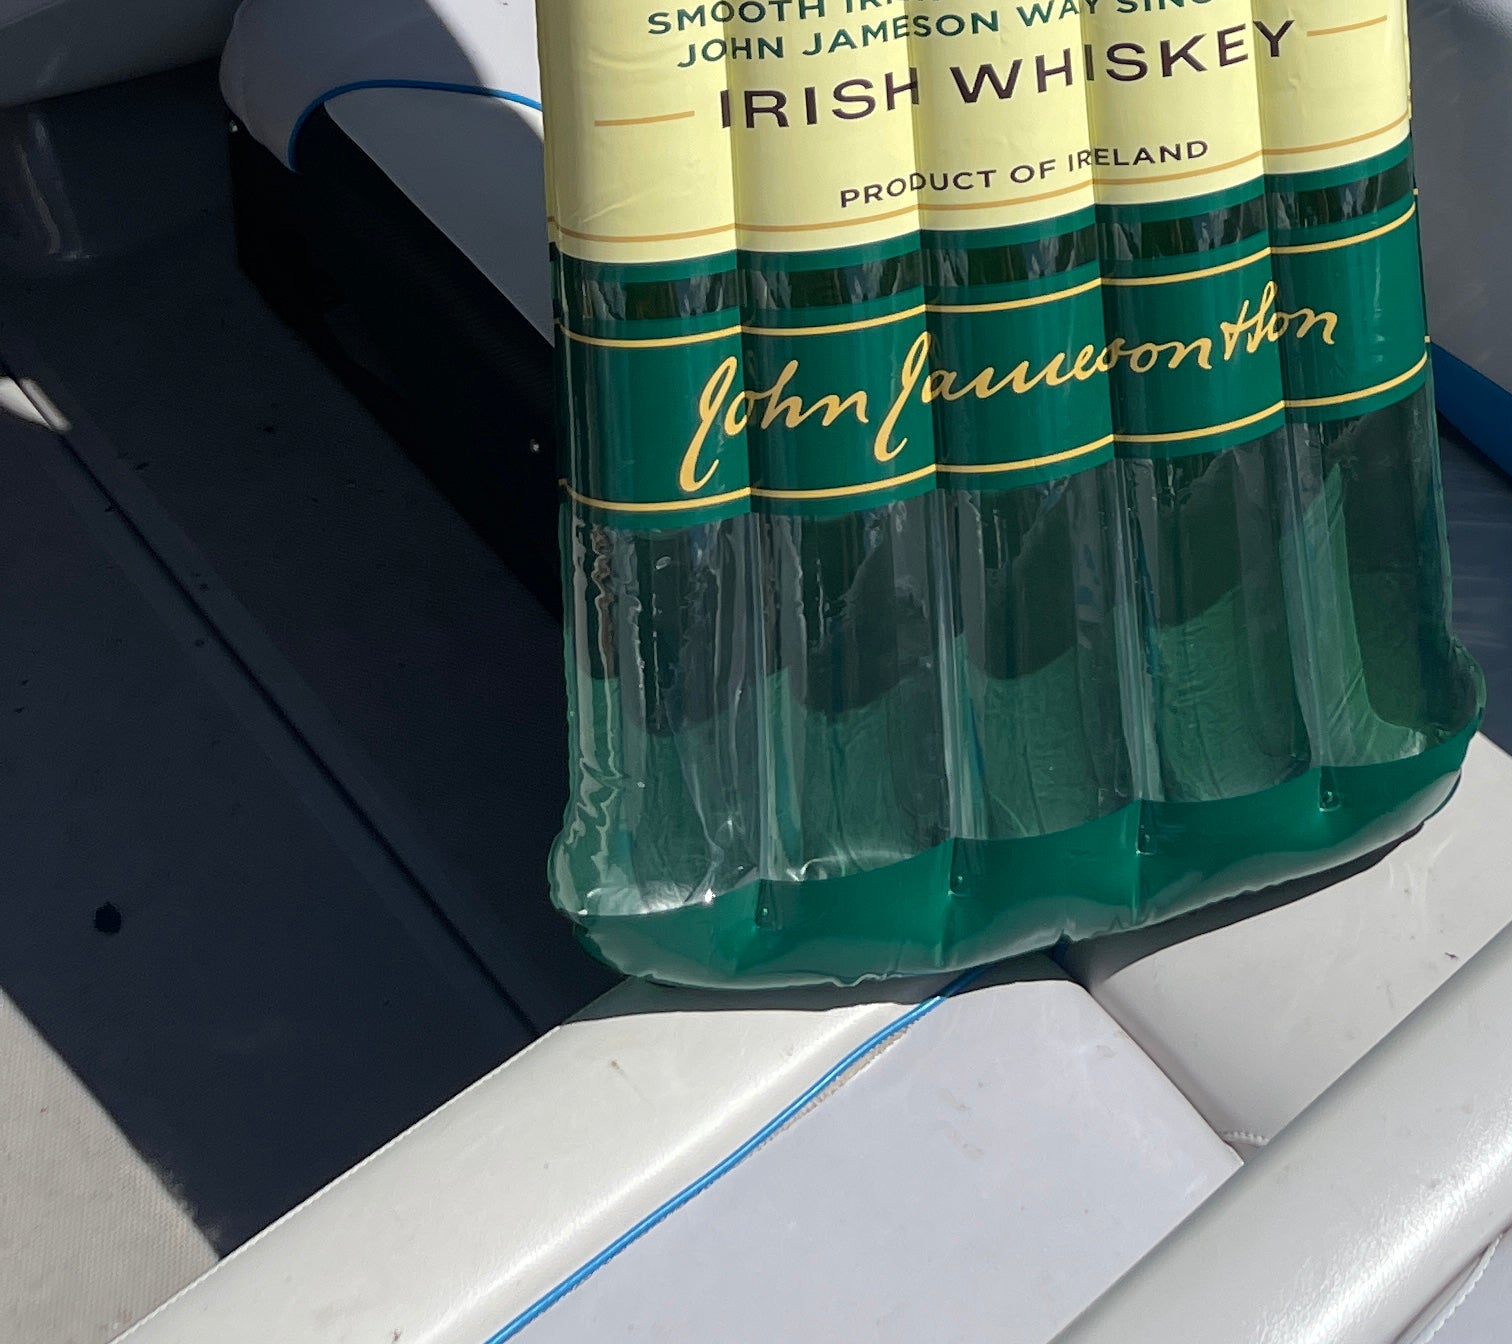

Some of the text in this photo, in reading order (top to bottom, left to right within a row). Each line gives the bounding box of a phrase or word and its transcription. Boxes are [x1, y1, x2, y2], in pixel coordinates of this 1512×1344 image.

[677, 36, 784, 68] JOHN
[802, 10, 999, 56] JAMESON
[720, 20, 1296, 130] IRISH WHISKEY
[840, 139, 1208, 208] PRODUCT OF IRELAND
[679, 356, 869, 493] John
